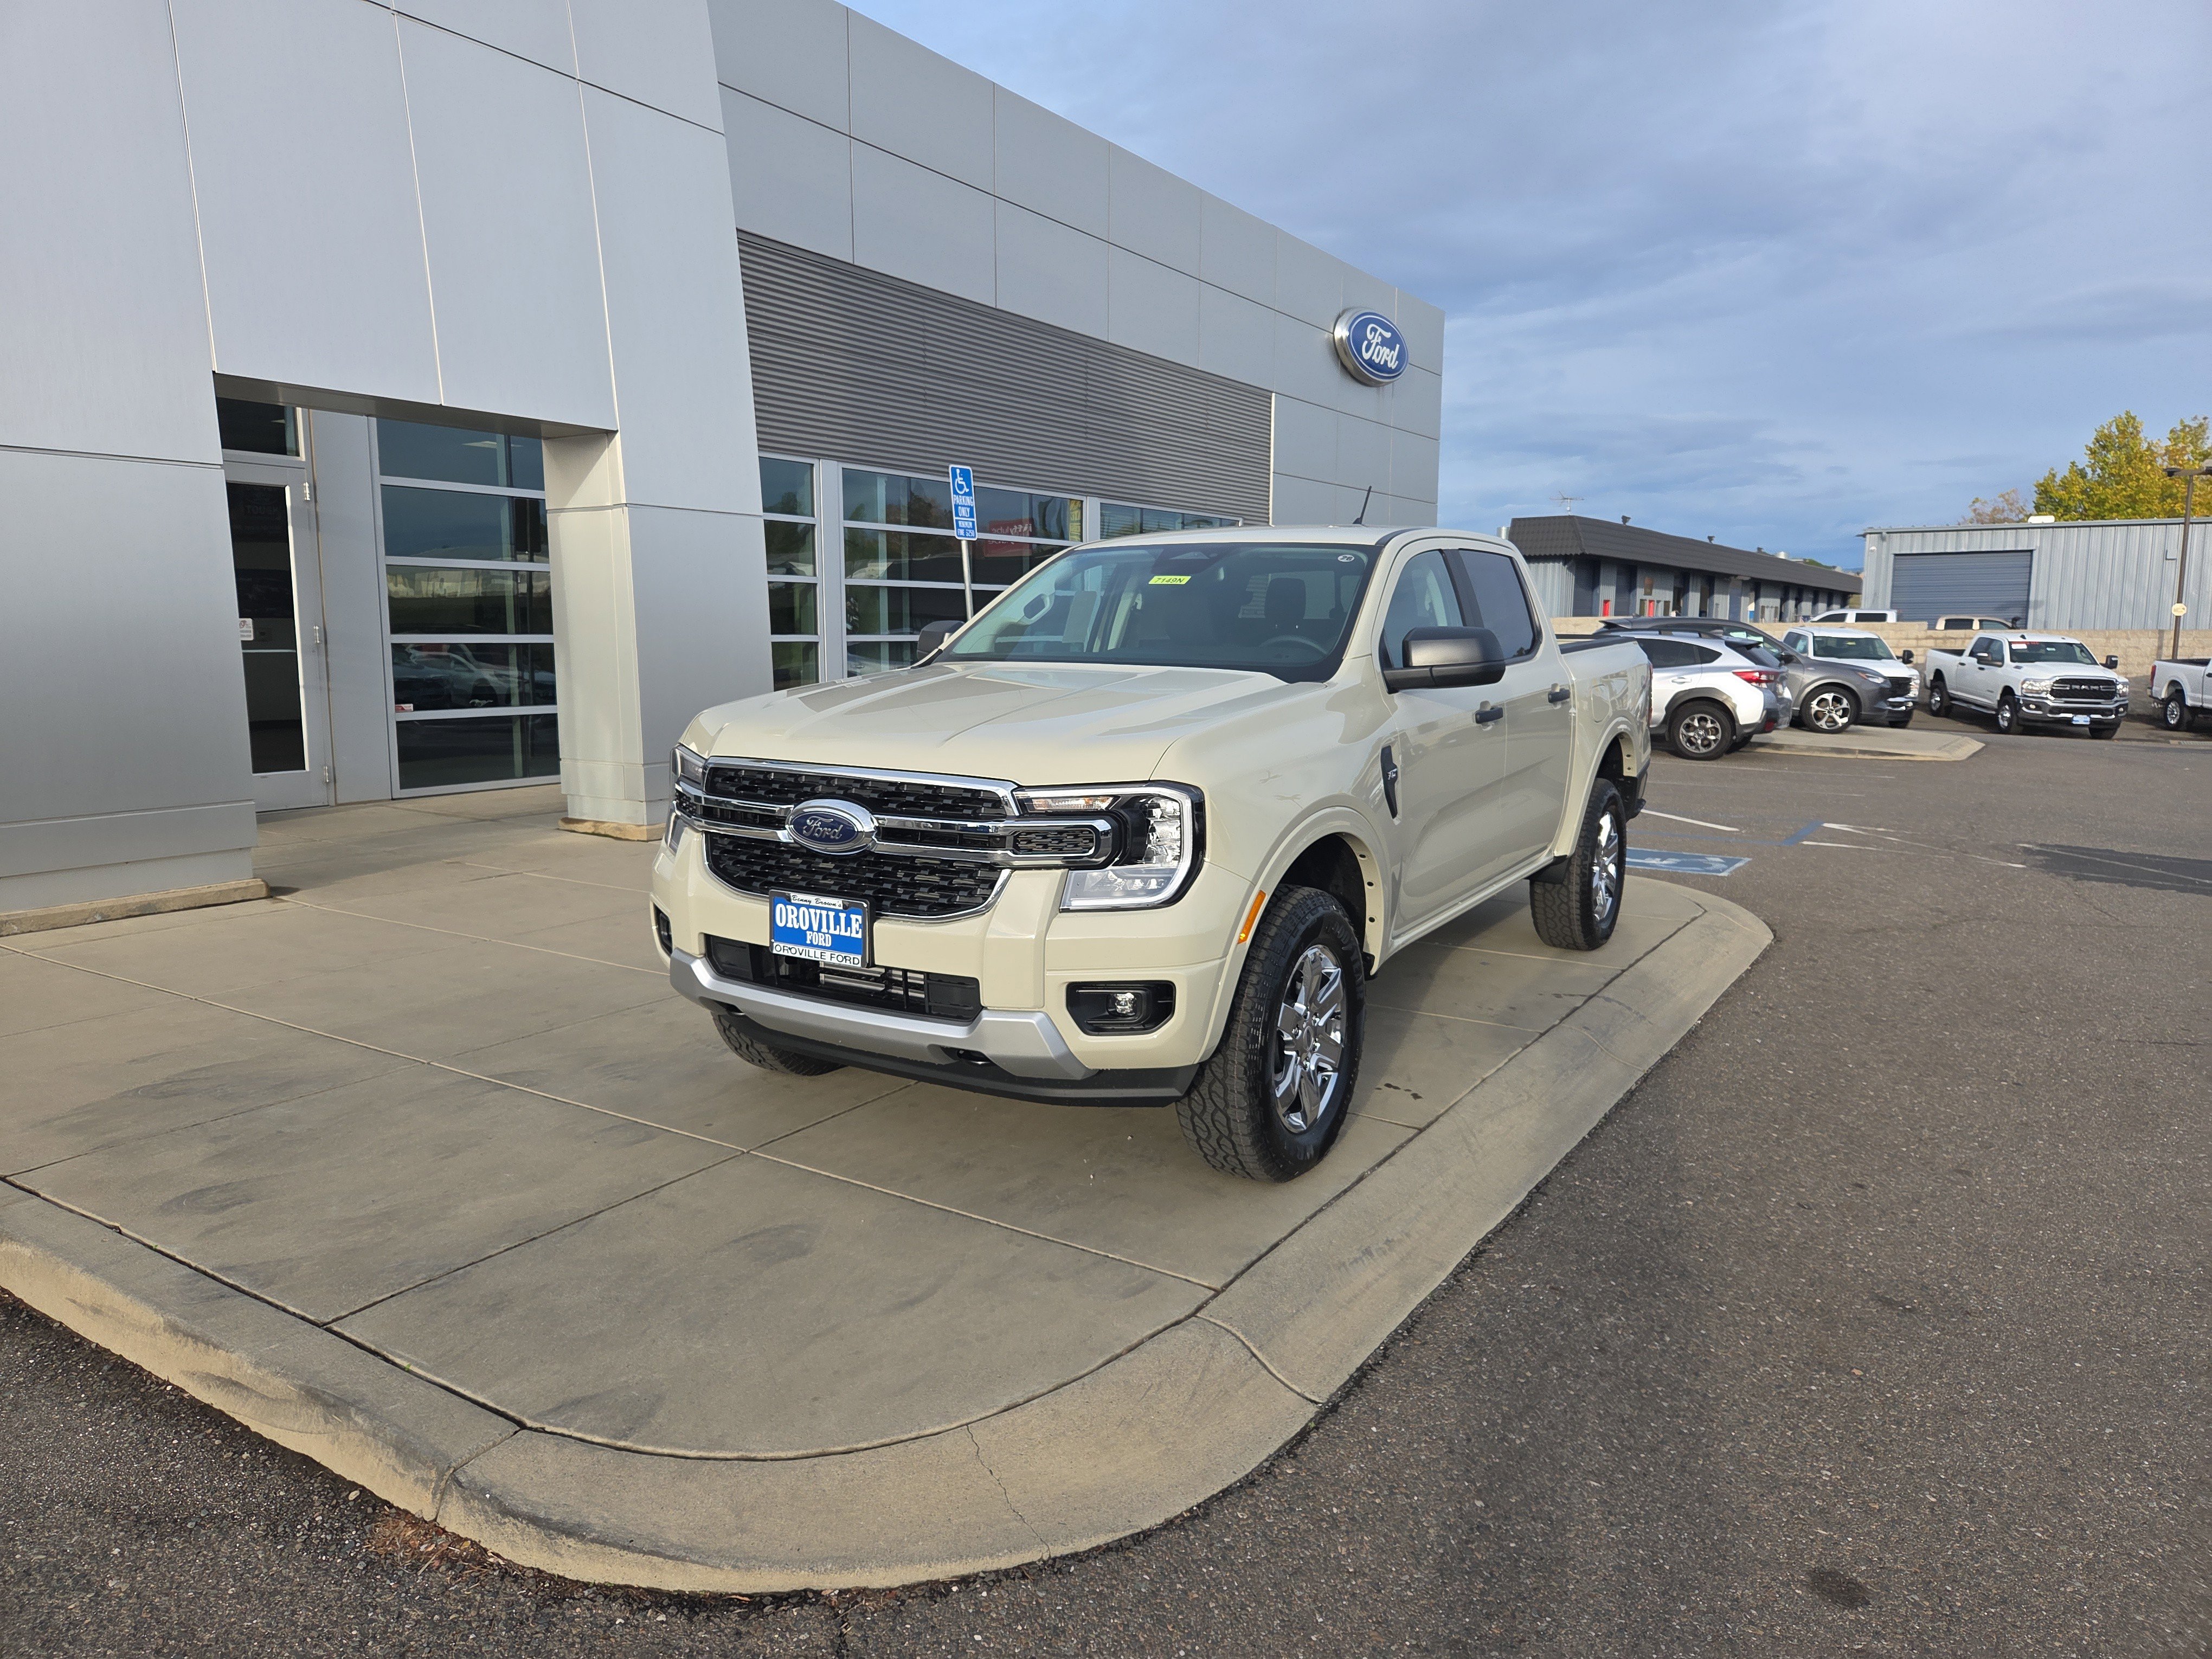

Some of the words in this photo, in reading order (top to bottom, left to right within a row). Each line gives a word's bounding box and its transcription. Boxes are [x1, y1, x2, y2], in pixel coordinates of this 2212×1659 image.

[1362, 324, 1400, 369] Ford
[953, 494, 974, 506] PARKING
[958, 506, 970, 517] ONLY
[803, 815, 843, 839] Ford
[792, 895, 812, 905] Benny
[815, 898, 842, 907] Brown's
[775, 903, 862, 938] OROVILLE
[806, 931, 832, 947] FORD
[775, 944, 826, 960] OROVILLE
[830, 954, 860, 965] FORD
